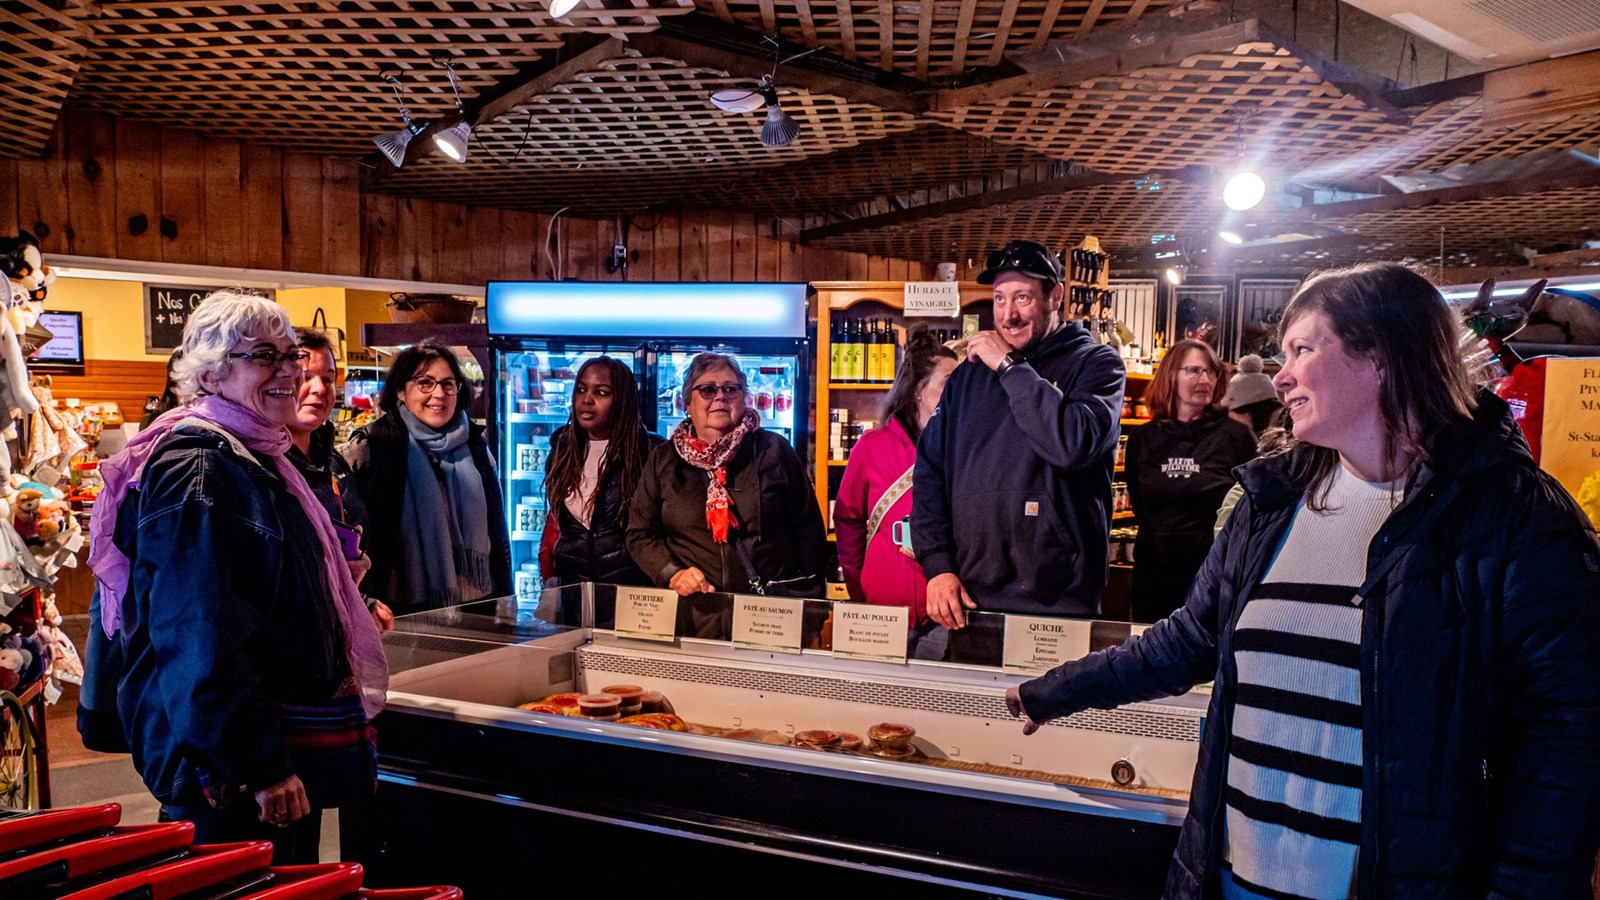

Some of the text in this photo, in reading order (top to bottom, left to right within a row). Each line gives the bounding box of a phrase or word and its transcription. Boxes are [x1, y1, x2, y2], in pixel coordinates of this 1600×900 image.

[908, 285, 940, 294] HUILES
[158, 291, 184, 310] Nos
[629, 594, 664, 602] TOURTIÈRE
[768, 607, 793, 615] SAUMON
[843, 611, 859, 619] PÂTÉ
[1029, 623, 1064, 633] QUICHE
[1034, 635, 1058, 643] LORRAINE
